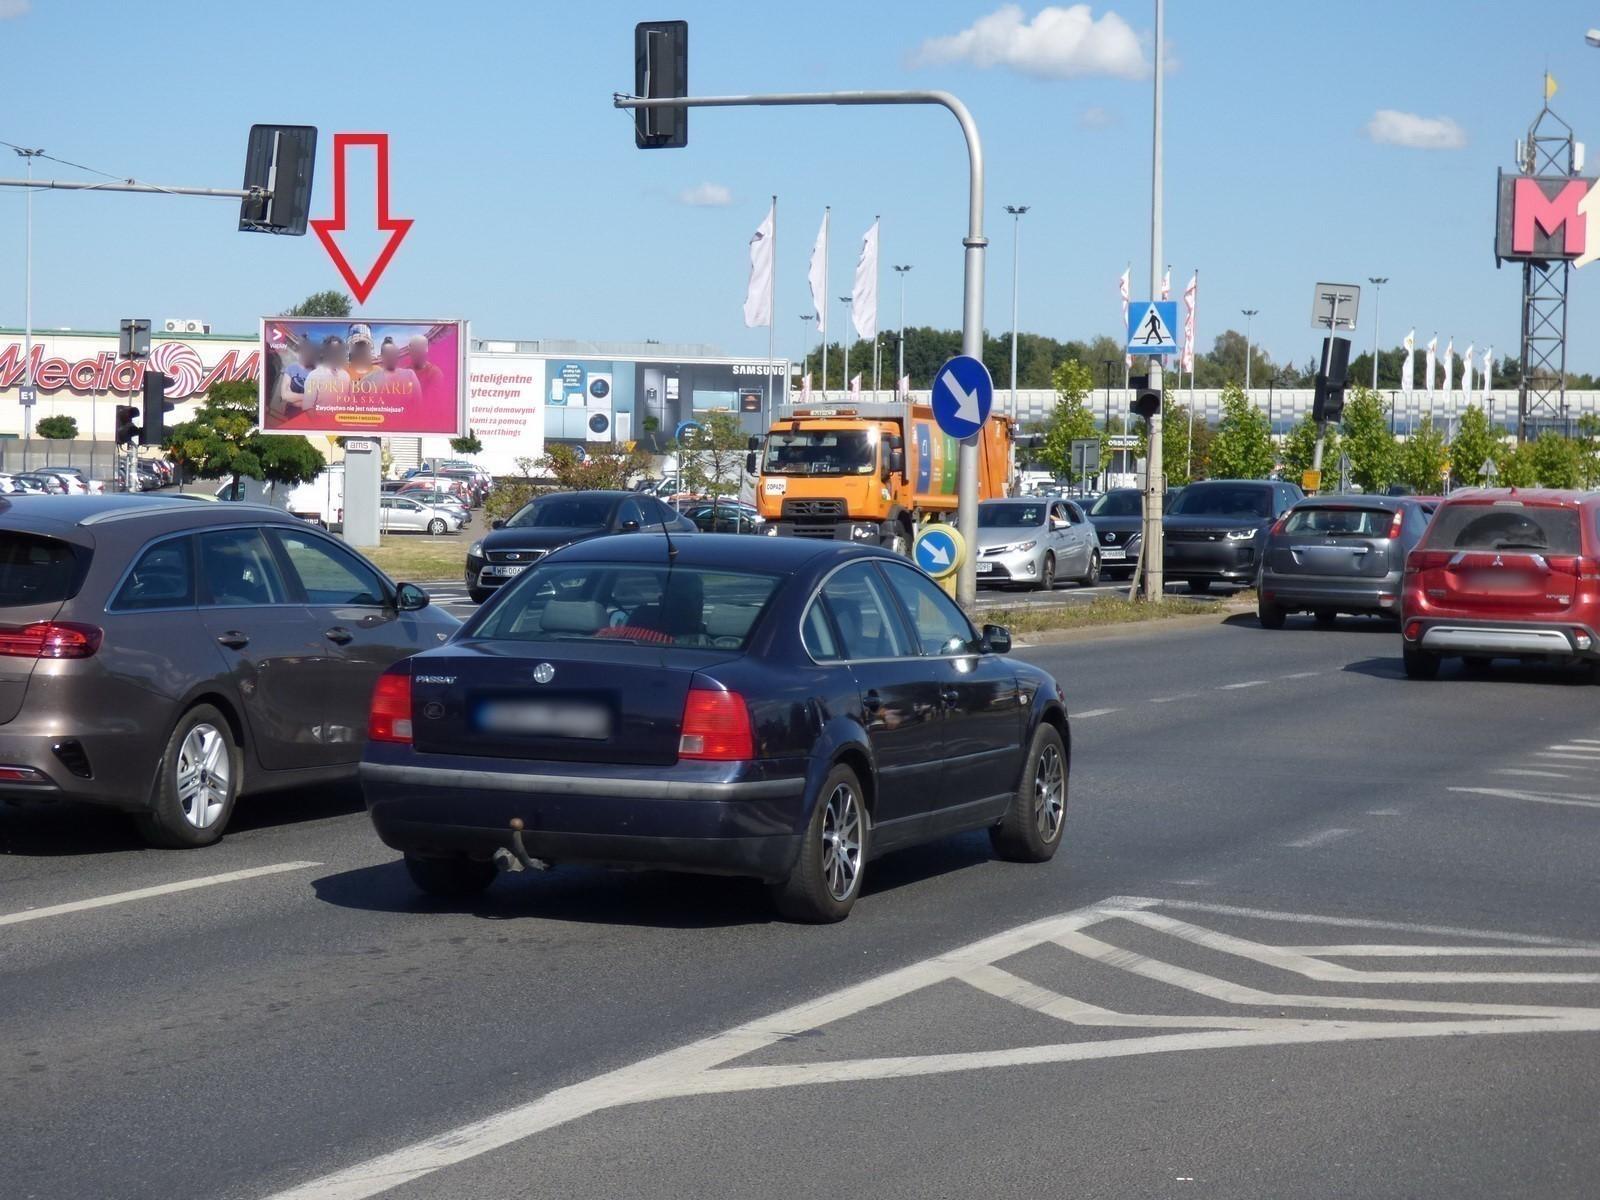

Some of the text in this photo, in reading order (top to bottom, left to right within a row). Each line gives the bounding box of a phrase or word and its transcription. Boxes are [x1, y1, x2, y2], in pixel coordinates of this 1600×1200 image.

[0, 343, 147, 392] Media
[732, 365, 785, 376] SAMSUNG
[470, 373, 533, 385] inteligentne
[307, 380, 413, 394] FORT BOYARD
[21, 391, 34, 400] E1
[471, 388, 521, 399] ytecznym
[336, 395, 385, 404] POLSKA
[350, 441, 369, 449] ams
[415, 675, 457, 685] PASSAT
